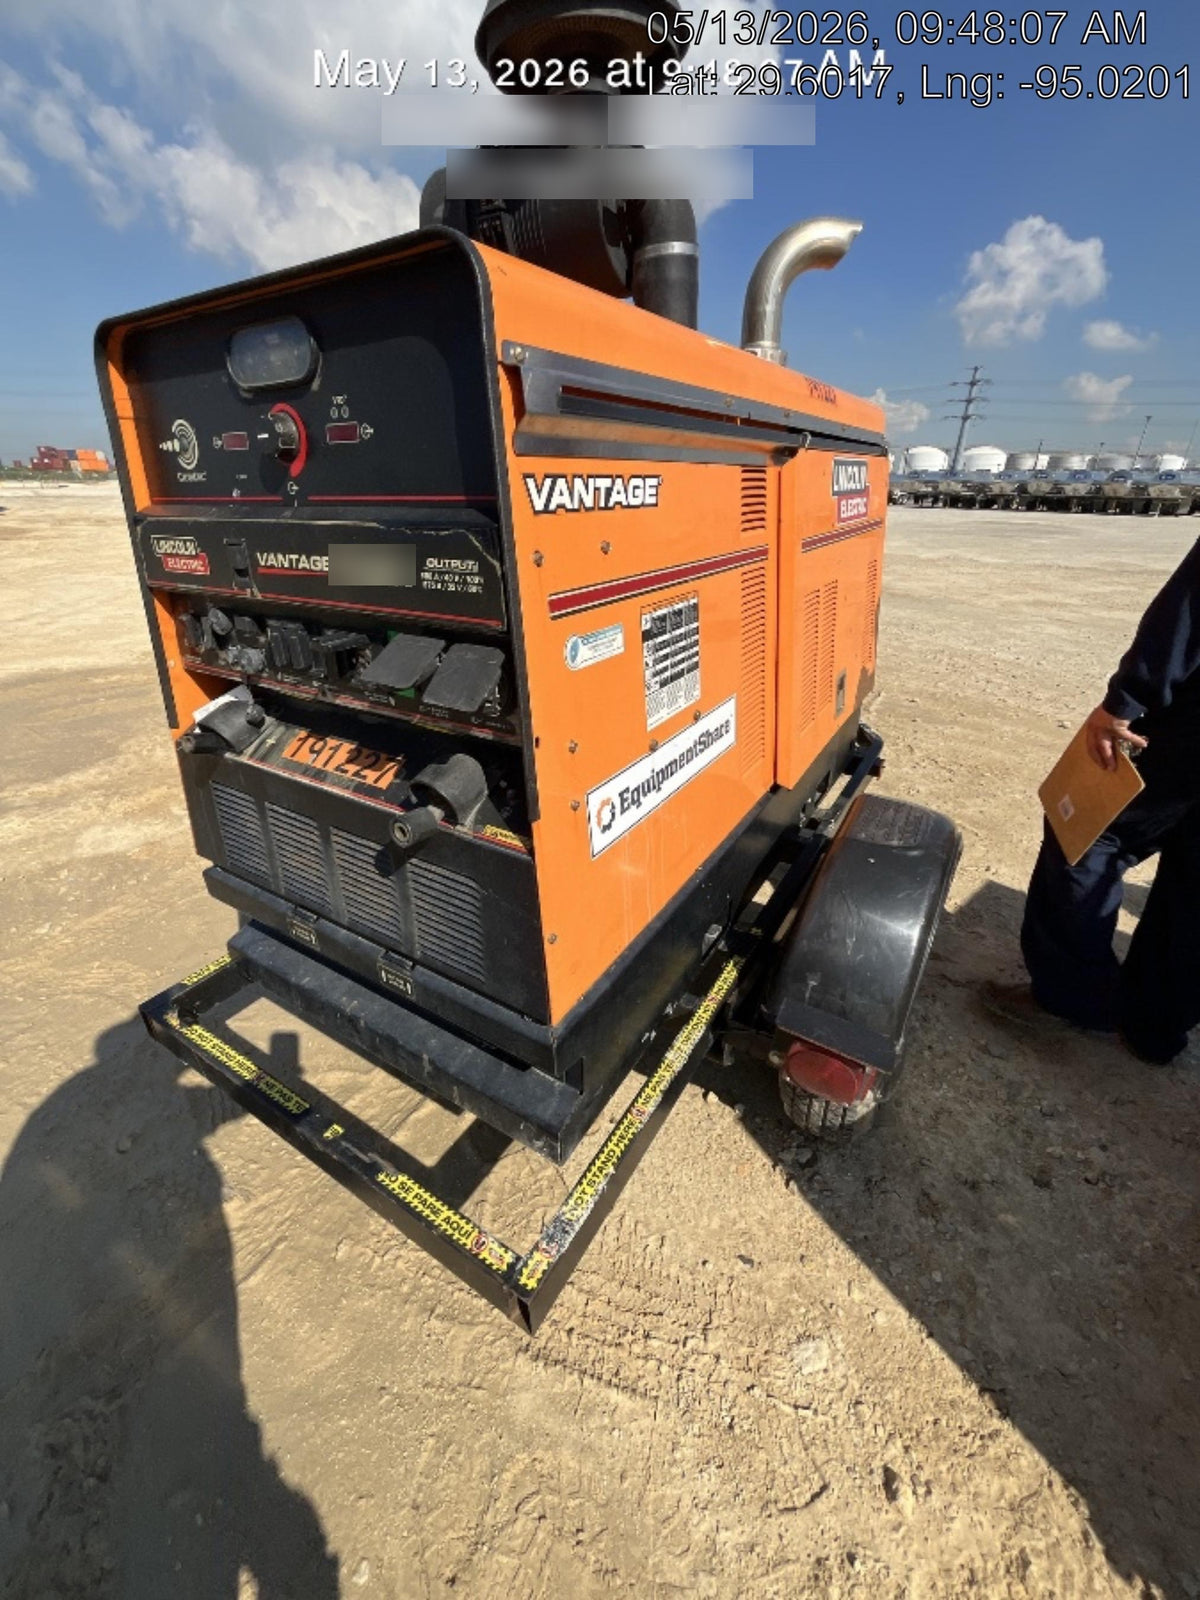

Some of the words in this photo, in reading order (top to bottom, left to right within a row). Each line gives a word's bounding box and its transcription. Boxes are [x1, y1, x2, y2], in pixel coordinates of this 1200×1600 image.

[522, 473, 660, 514] VANTAGE
[833, 463, 867, 491] LINCOLN
[840, 496, 867, 518] ELECTRIC
[289, 732, 402, 784] 191227
[618, 719, 731, 817] EquipmentShare
[585, 1147, 616, 1188] STAND
[397, 1179, 415, 1196] SE
[411, 1190, 443, 1218] PARE
